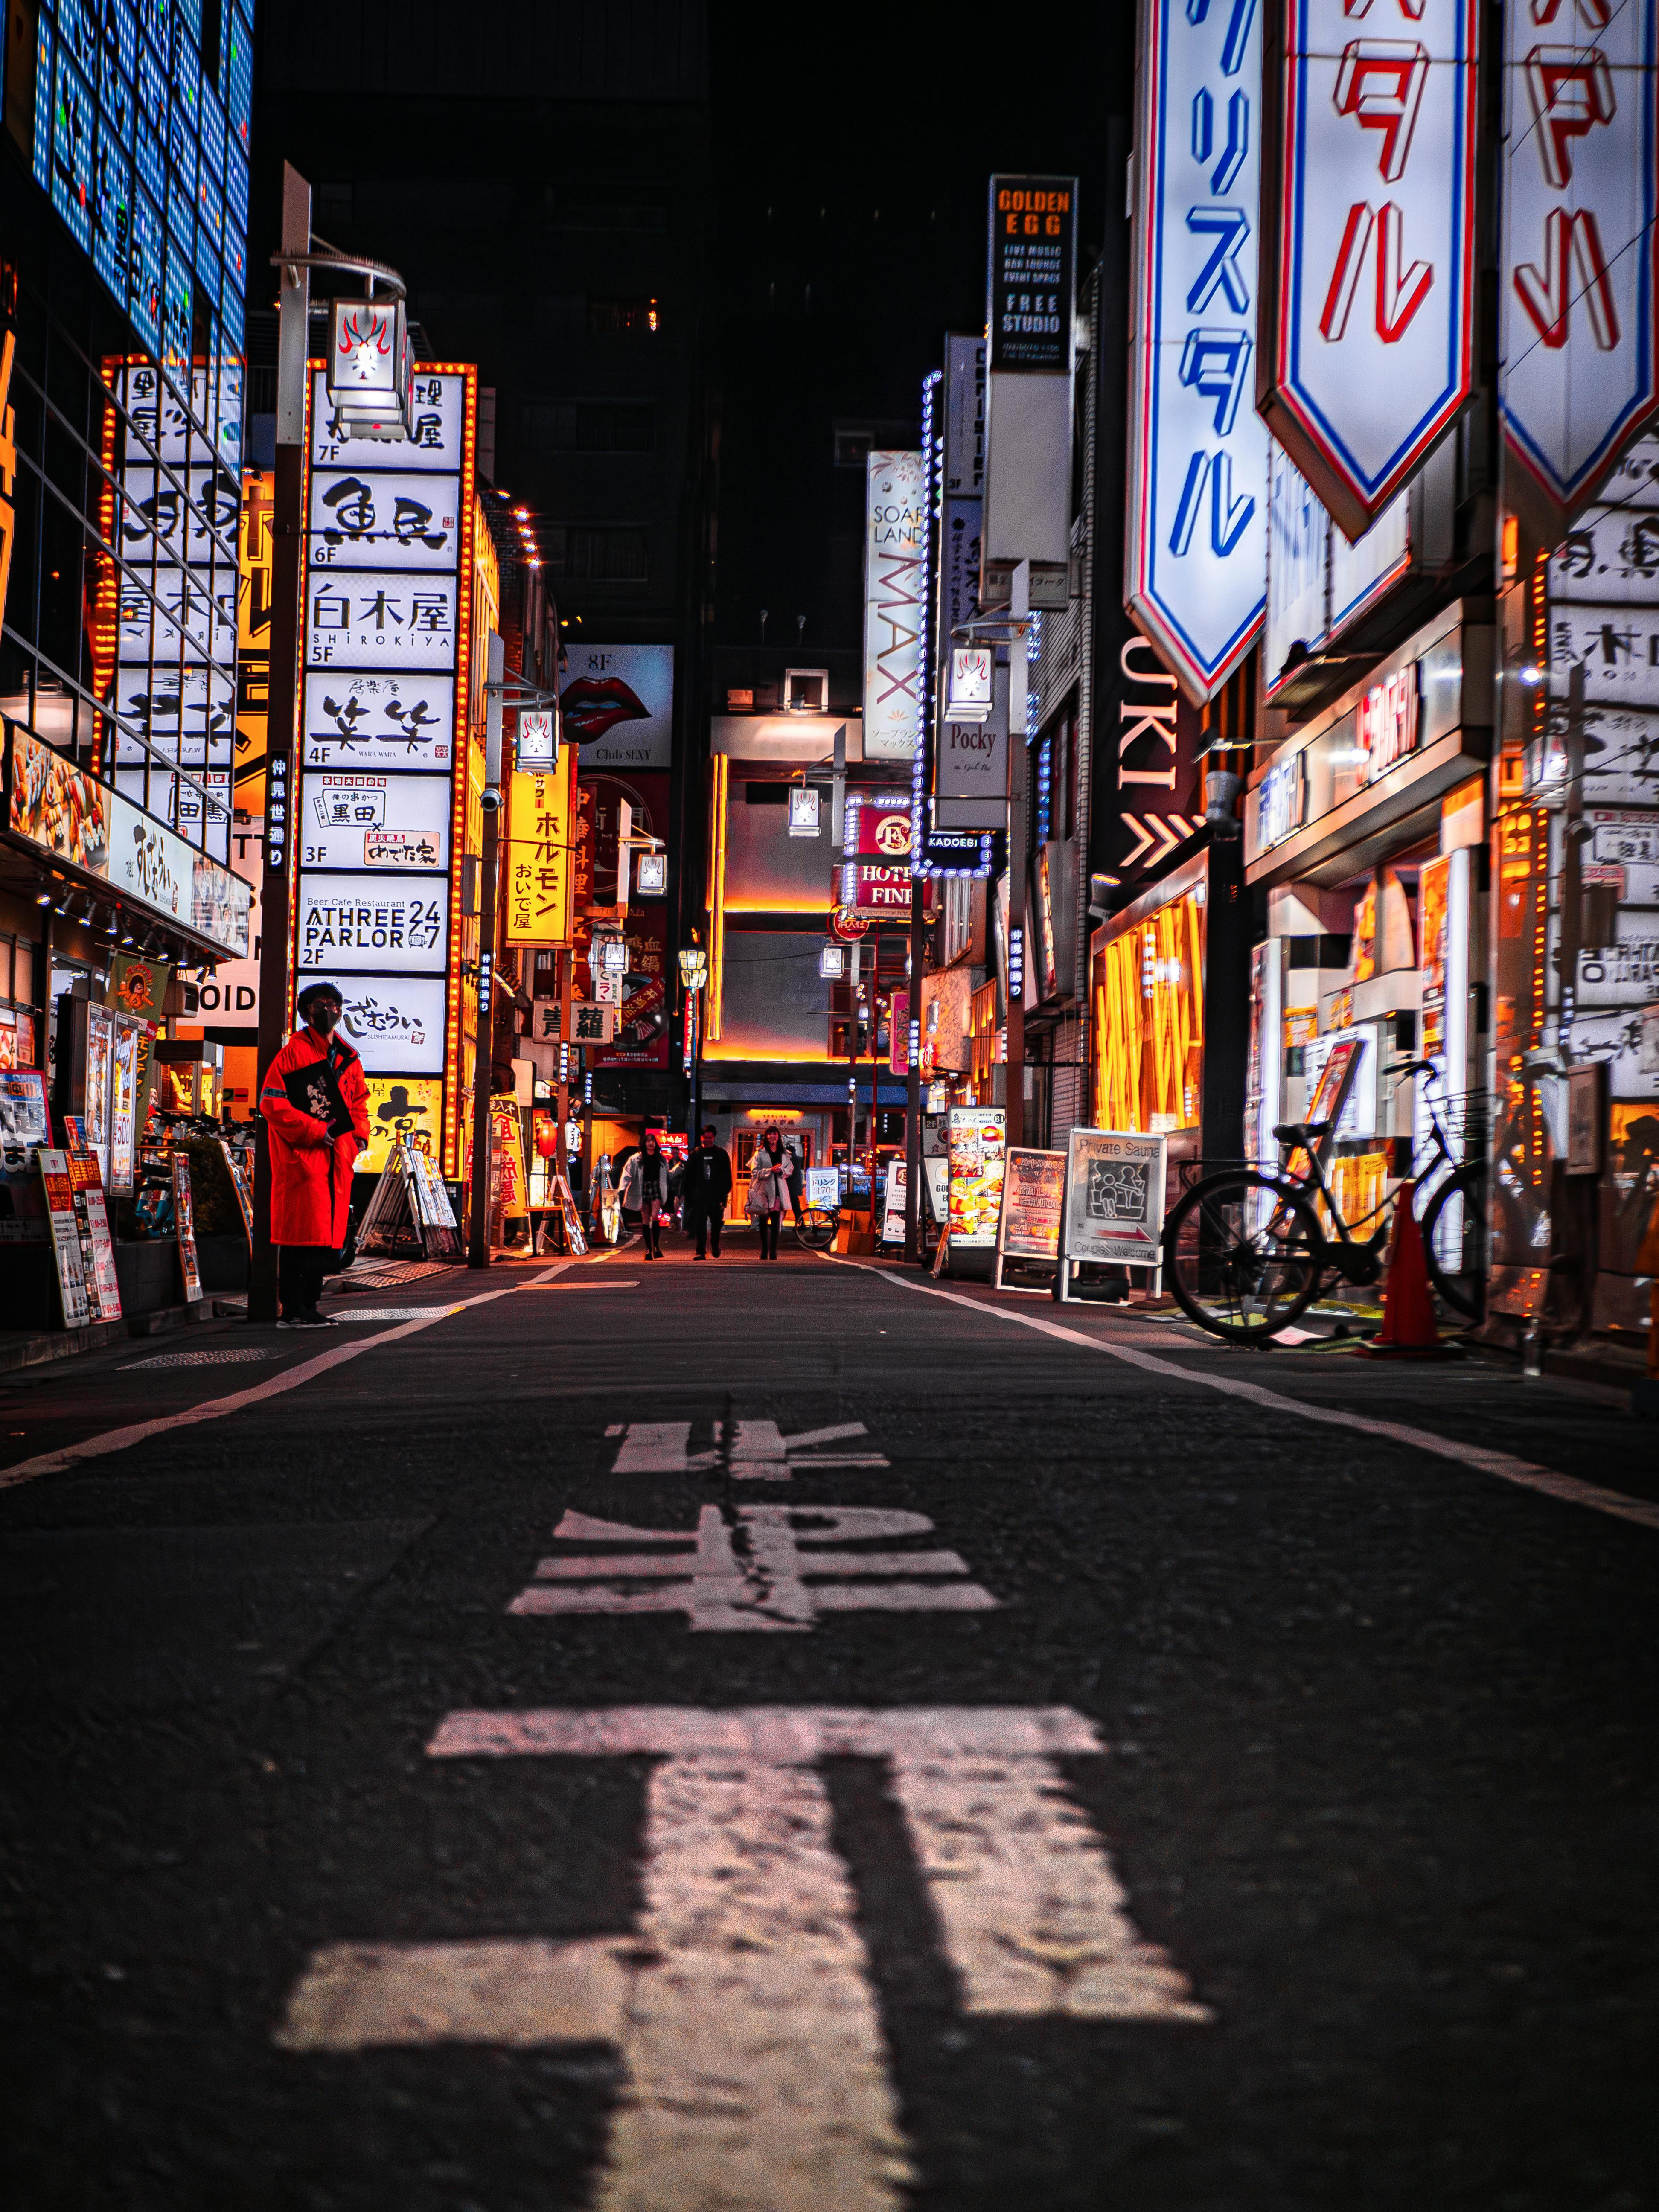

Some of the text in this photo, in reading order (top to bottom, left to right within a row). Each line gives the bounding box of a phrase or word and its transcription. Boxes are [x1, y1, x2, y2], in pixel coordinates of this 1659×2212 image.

[1318, 0, 1435, 344] タル
[998, 189, 1069, 212] GOLDEN
[1006, 213, 1061, 236] EGG
[1006, 293, 1058, 313] FREE
[1002, 313, 1061, 333] STUDIO
[318, 445, 340, 461] 7F
[322, 476, 448, 550] 魚民
[314, 547, 336, 563] 6F
[313, 583, 452, 632] 白木屋
[876, 552, 924, 706] MAX
[312, 646, 333, 662] 5F
[588, 654, 612, 671] 8F
[309, 695, 441, 754] 笑笑
[872, 729, 917, 739] ソープラン
[950, 723, 997, 758] Pocky
[309, 747, 331, 763] 4F
[596, 748, 652, 760] Club SEXY
[323, 776, 387, 787] 本場大阪の味
[332, 792, 378, 803] 俺の串かつ
[269, 759, 287, 866] 仲見世通り
[331, 803, 376, 823] 黒田
[367, 834, 405, 844] 炭火焼鳥
[928, 838, 977, 847] KADOEBI
[305, 846, 327, 862] 3F
[368, 838, 437, 864] めでた家
[534, 812, 561, 918] ホルモン
[332, 898, 352, 906] Cafe
[355, 899, 405, 908] Restaurant
[513, 863, 532, 929] おいで屋
[306, 907, 405, 928] ATHREE
[306, 927, 404, 948] PARLOR
[303, 949, 324, 964] 2F
[1010, 929, 1023, 996] 仲見世通り
[480, 953, 491, 1012] 仲見世通り
[1080, 1139, 1160, 1158] Private Sauna
[812, 1178, 836, 1186] ドリンク
